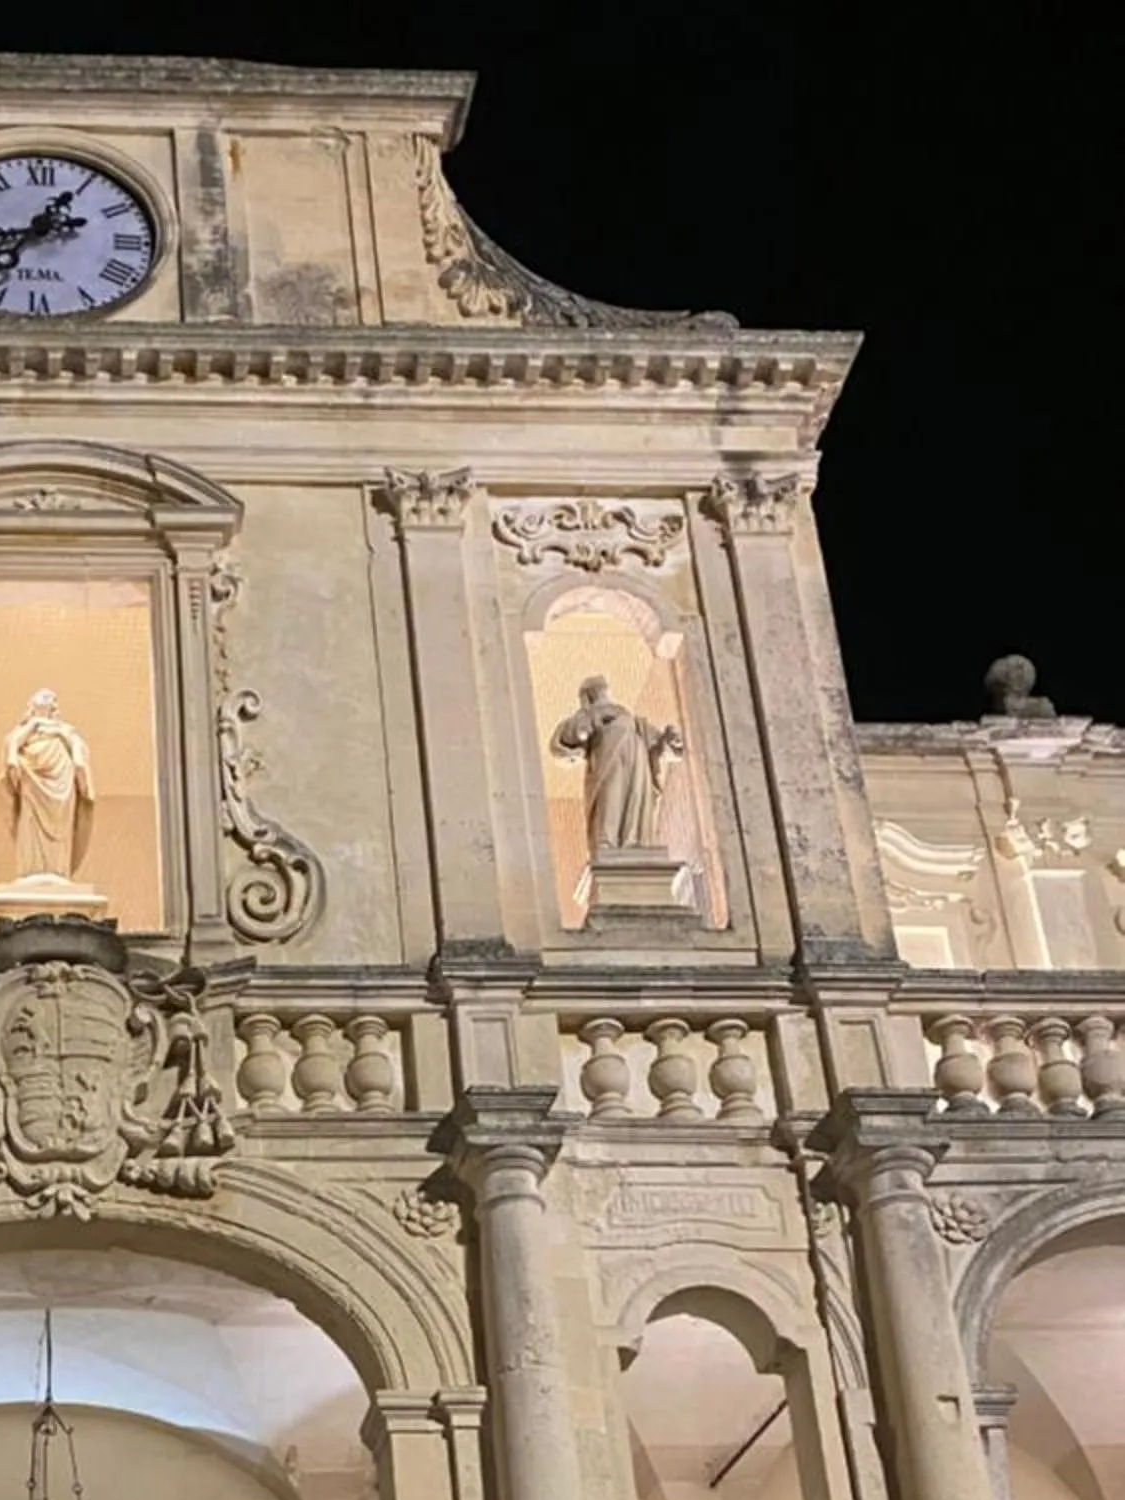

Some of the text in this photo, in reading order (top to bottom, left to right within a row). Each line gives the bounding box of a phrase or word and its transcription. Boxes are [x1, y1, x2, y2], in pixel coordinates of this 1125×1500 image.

[26, 164, 55, 187] XII
[100, 202, 131, 219] II
[113, 232, 142, 251] III
[98, 258, 138, 288] IIII
